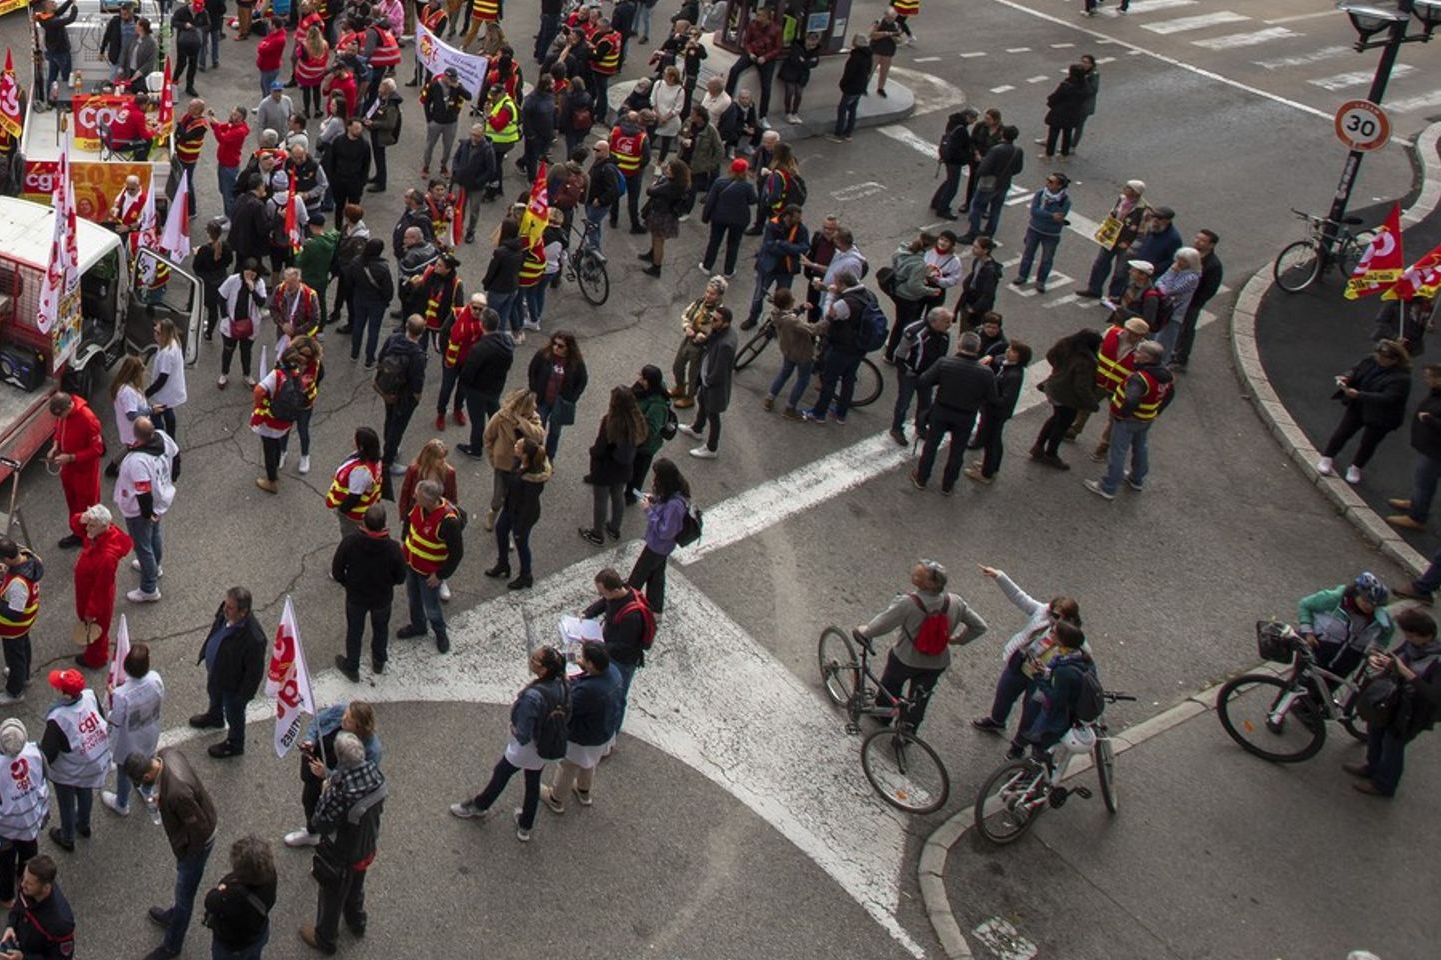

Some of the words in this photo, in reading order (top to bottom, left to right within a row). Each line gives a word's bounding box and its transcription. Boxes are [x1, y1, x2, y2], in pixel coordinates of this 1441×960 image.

[1346, 114, 1375, 137] 30
[26, 173, 52, 190] cg
[78, 711, 100, 734] cgt
